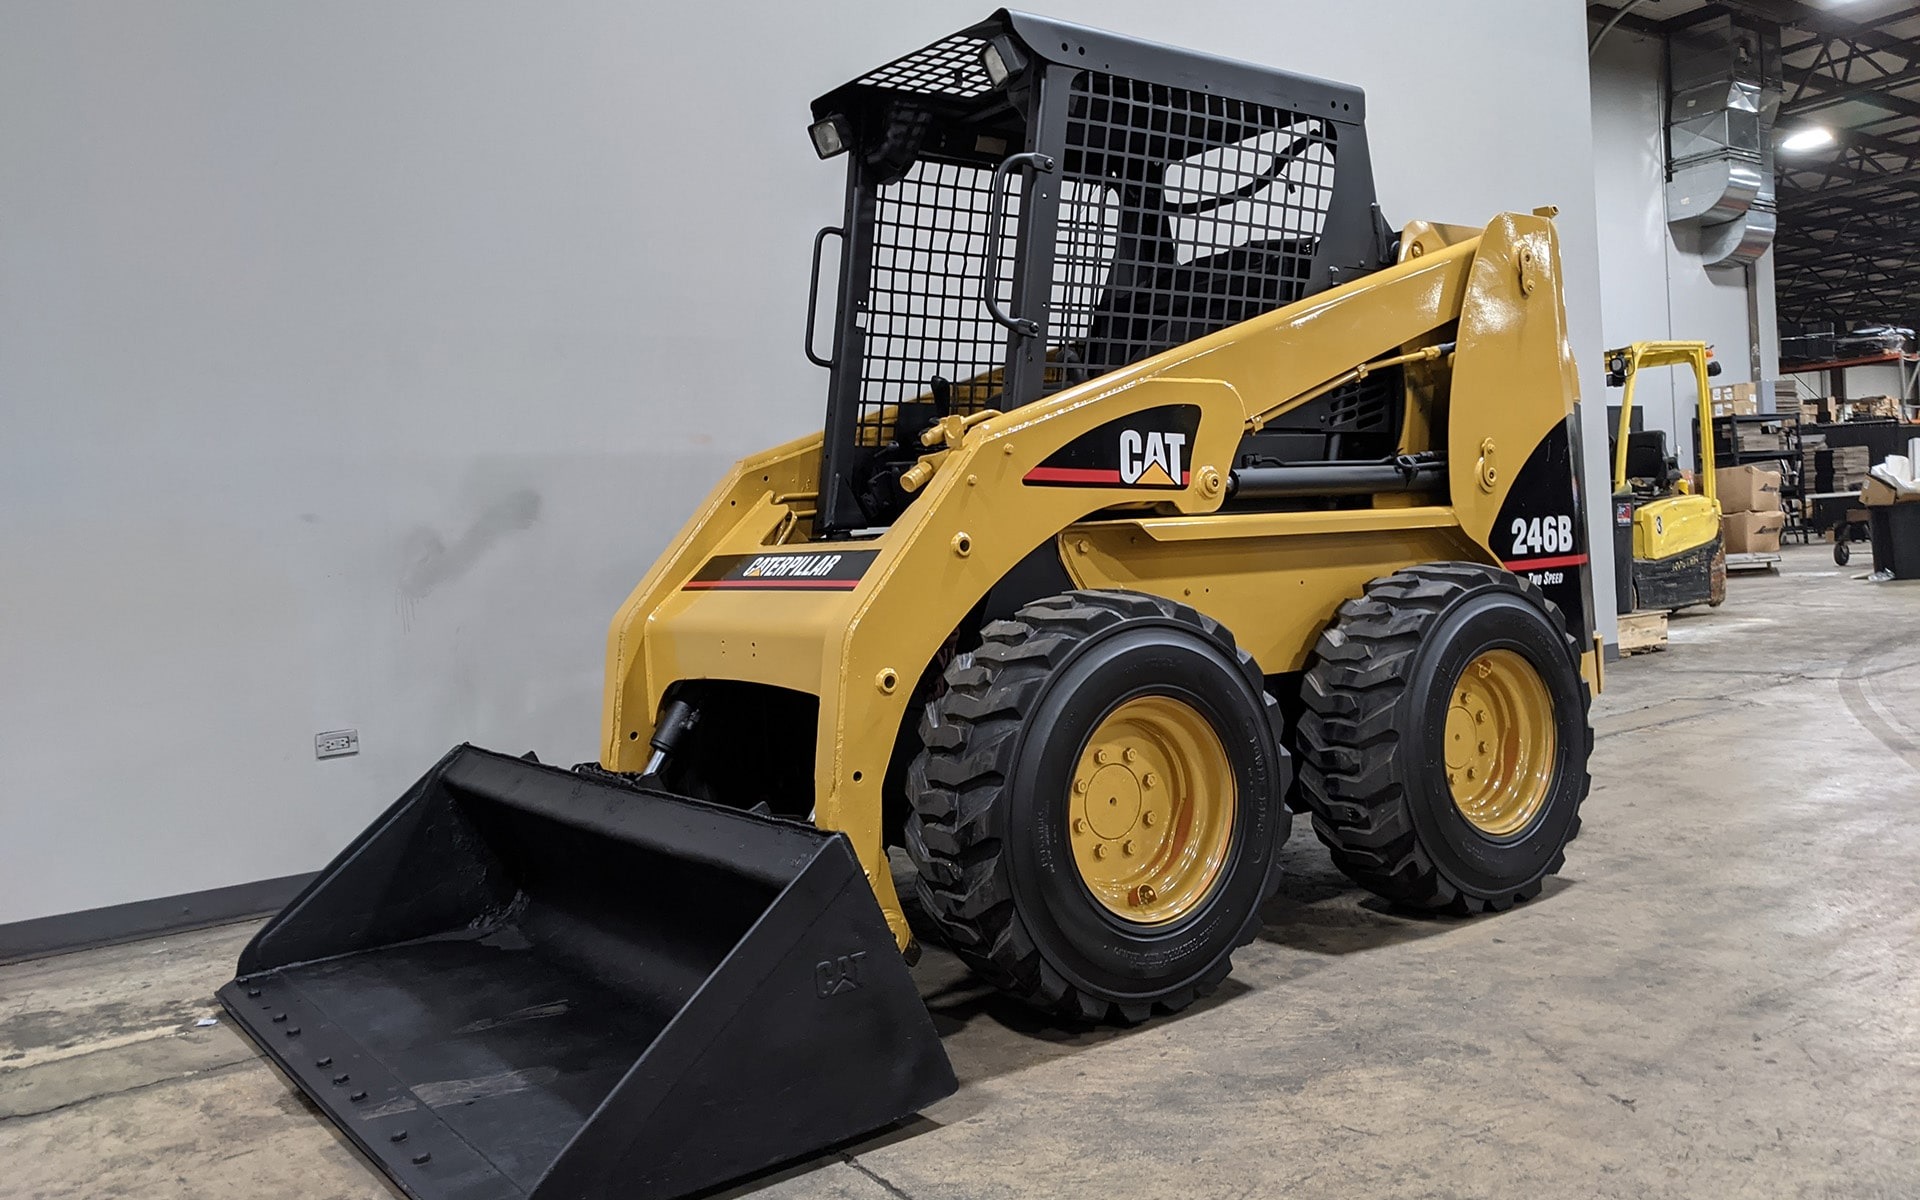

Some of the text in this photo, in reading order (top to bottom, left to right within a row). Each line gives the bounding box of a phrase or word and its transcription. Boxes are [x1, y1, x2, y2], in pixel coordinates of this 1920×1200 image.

[1119, 429, 1186, 486] CAT
[1511, 514, 1573, 555] 246B
[1655, 515, 1663, 535] 3
[742, 554, 842, 577] CATERPILLAR
[815, 950, 867, 999] CAT
